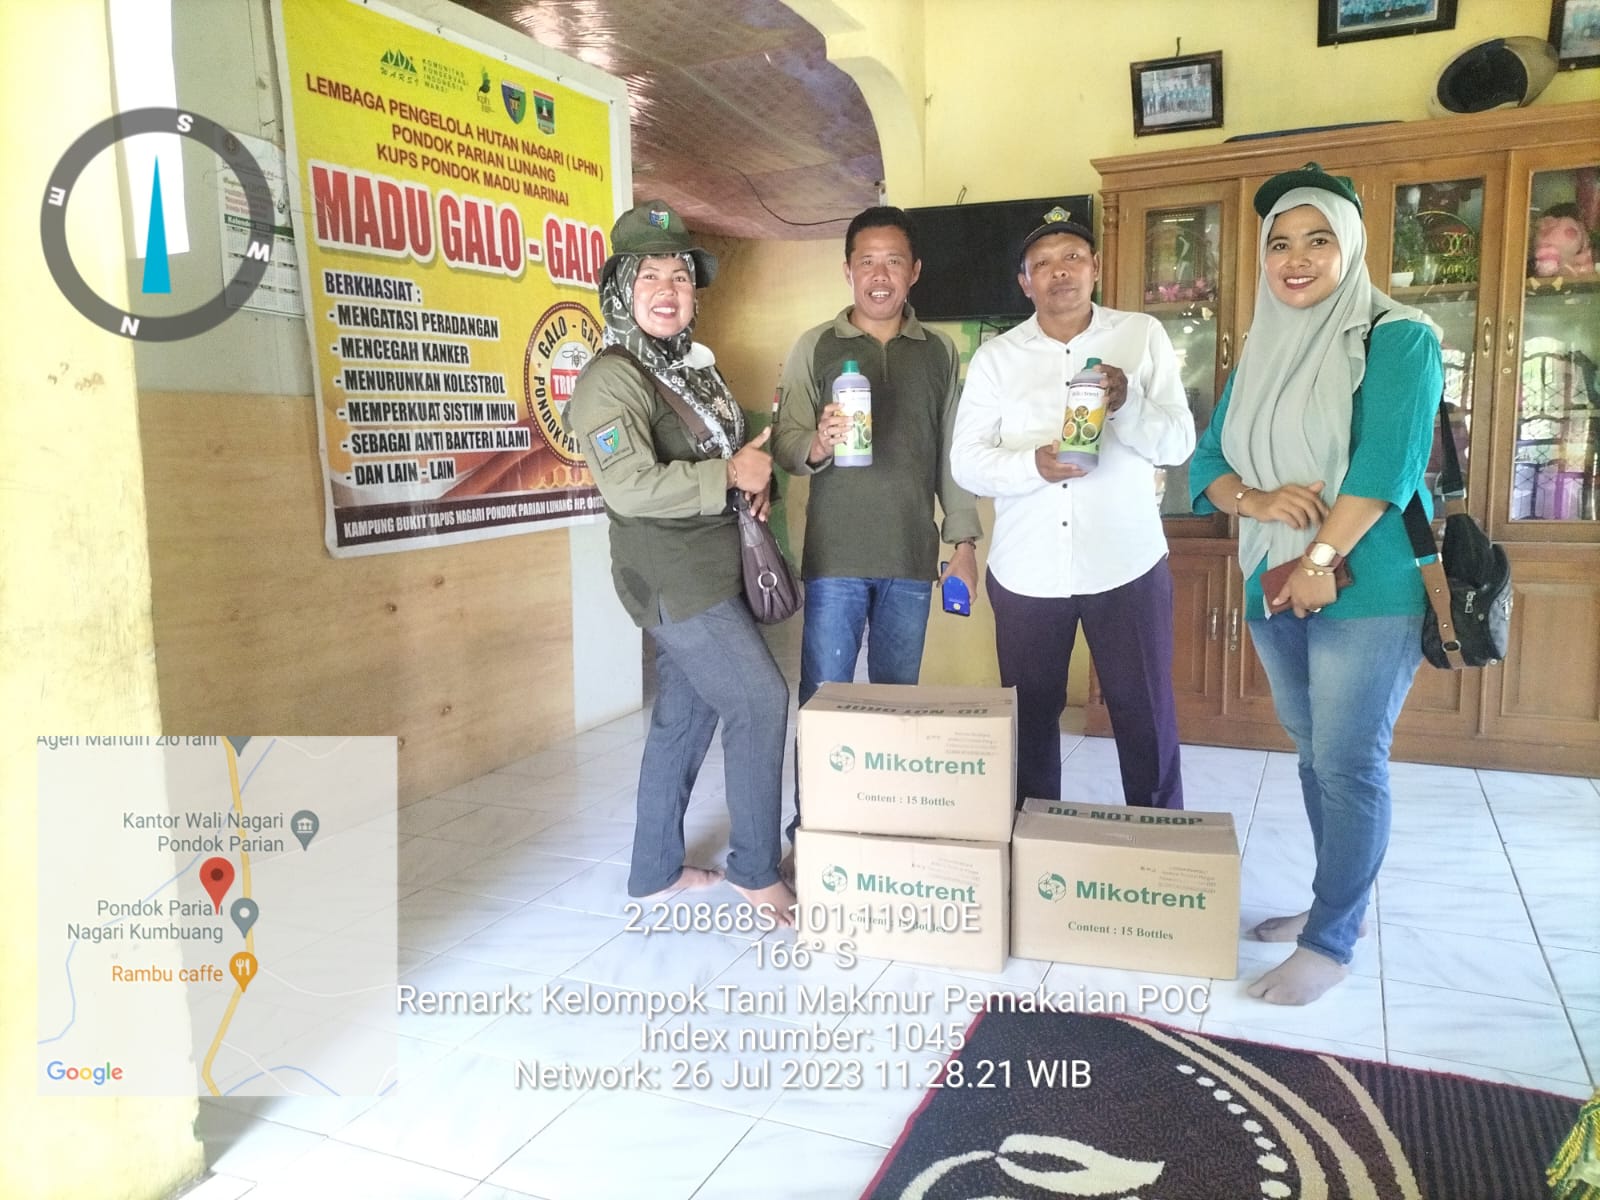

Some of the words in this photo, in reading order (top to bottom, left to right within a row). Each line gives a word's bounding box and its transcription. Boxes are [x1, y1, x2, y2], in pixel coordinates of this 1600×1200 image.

[306, 72, 386, 114] LEMBAGA
[389, 99, 474, 140] PENGELOLA
[476, 125, 519, 152] HUTAN
[521, 140, 564, 166] NAGARI
[572, 156, 599, 176] LPHN
[392, 124, 454, 156] PONDOK
[457, 143, 505, 168] PARIAN
[507, 157, 556, 183] LUNANG
[376, 143, 418, 168] KUPS
[422, 155, 480, 184] PONDOK
[483, 172, 520, 194] MADU
[523, 183, 569, 206] MARINAI
[312, 165, 432, 256] MADU
[439, 194, 523, 272] GALO
[546, 217, 606, 284] GALO
[325, 272, 413, 302] BERKHASIAT
[338, 304, 418, 331] MENGATASI
[422, 313, 499, 338] PERADANGAN
[341, 337, 419, 361] MENCEGAH
[422, 342, 470, 364] KANKER
[538, 316, 568, 359] GALO
[344, 370, 441, 392] MENURUNKAN
[444, 373, 506, 394] KOLESTROL
[348, 402, 441, 422] MEMPERKUAT
[444, 403, 484, 422] SISTIM
[487, 403, 516, 421] IMUN
[534, 375, 562, 443] PONDOK
[352, 432, 411, 454] SEBAGAI
[415, 431, 444, 451] ANTI
[447, 431, 493, 450] BAKTERI
[496, 430, 529, 449] ALAMI
[354, 465, 384, 486] DAN
[387, 461, 418, 483] LAIN
[429, 460, 455, 480] LAIN
[344, 517, 395, 538] KAMPUNG
[396, 515, 427, 532] BUKIT
[428, 510, 455, 527] TAPUS
[456, 507, 485, 524] NAGARI
[486, 503, 517, 520] PONDOK
[518, 501, 545, 516] PARIAN
[546, 498, 573, 514] LUNANG
[865, 752, 986, 776] Mikotrent
[857, 792, 898, 806] Content
[906, 795, 918, 806] 15
[920, 796, 956, 808] Bottles
[1048, 806, 1078, 817] DO
[1091, 811, 1134, 822] NOT
[1140, 815, 1203, 826] DROP
[857, 873, 977, 903] Mikotrent
[1076, 880, 1207, 911] Mikotrent
[1068, 920, 1109, 935] Content
[1120, 925, 1133, 936] 15
[1136, 926, 1174, 941] Bottles
